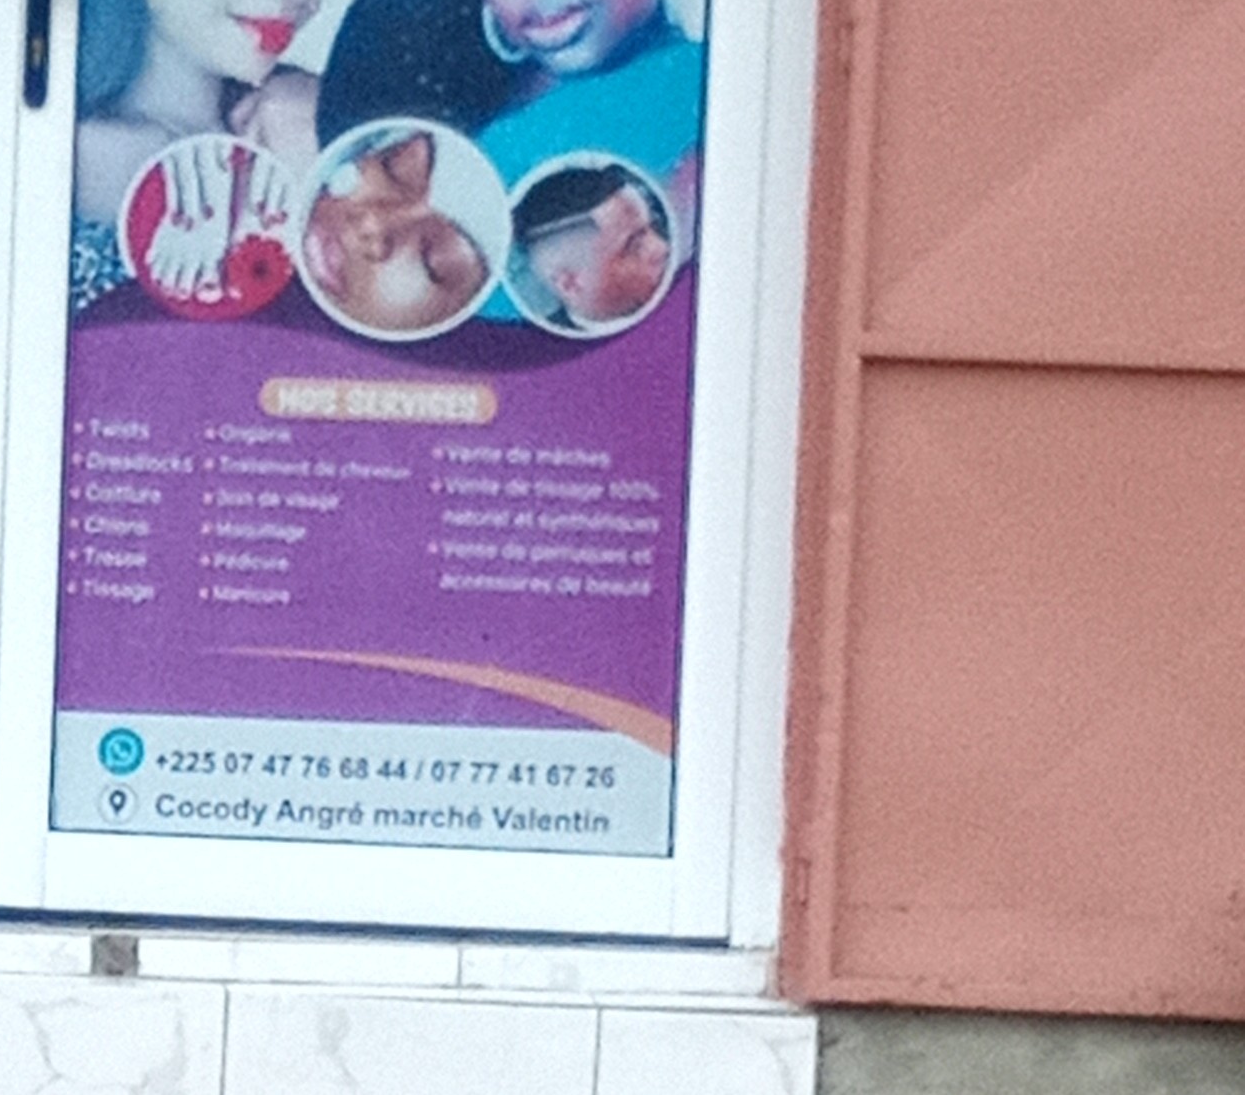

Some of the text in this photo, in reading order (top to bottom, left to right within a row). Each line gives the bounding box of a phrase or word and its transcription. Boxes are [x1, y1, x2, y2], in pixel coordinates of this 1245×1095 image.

[277, 386, 479, 420] NOS SERVICES
[86, 451, 193, 474] Dreadlocks
[445, 446, 502, 464] Vente
[506, 446, 532, 465] de
[220, 455, 310, 476] Traitement
[340, 461, 412, 480] cheveux
[85, 482, 161, 504] Coiffure
[445, 478, 500, 496] Vente
[504, 478, 530, 497] de
[534, 480, 604, 502] tissage
[284, 492, 340, 512] visage
[513, 511, 533, 528] et
[216, 522, 307, 544] Maquillage
[442, 541, 498, 560] Vente
[501, 541, 527, 560] de
[631, 546, 654, 565] et
[83, 579, 155, 603] Tissage
[556, 575, 581, 595] de
[155, 750, 615, 789] +225 07 47 76 68 44 / 07 77 41 67 26
[155, 794, 610, 833] Cocody Angré marché Valentin
